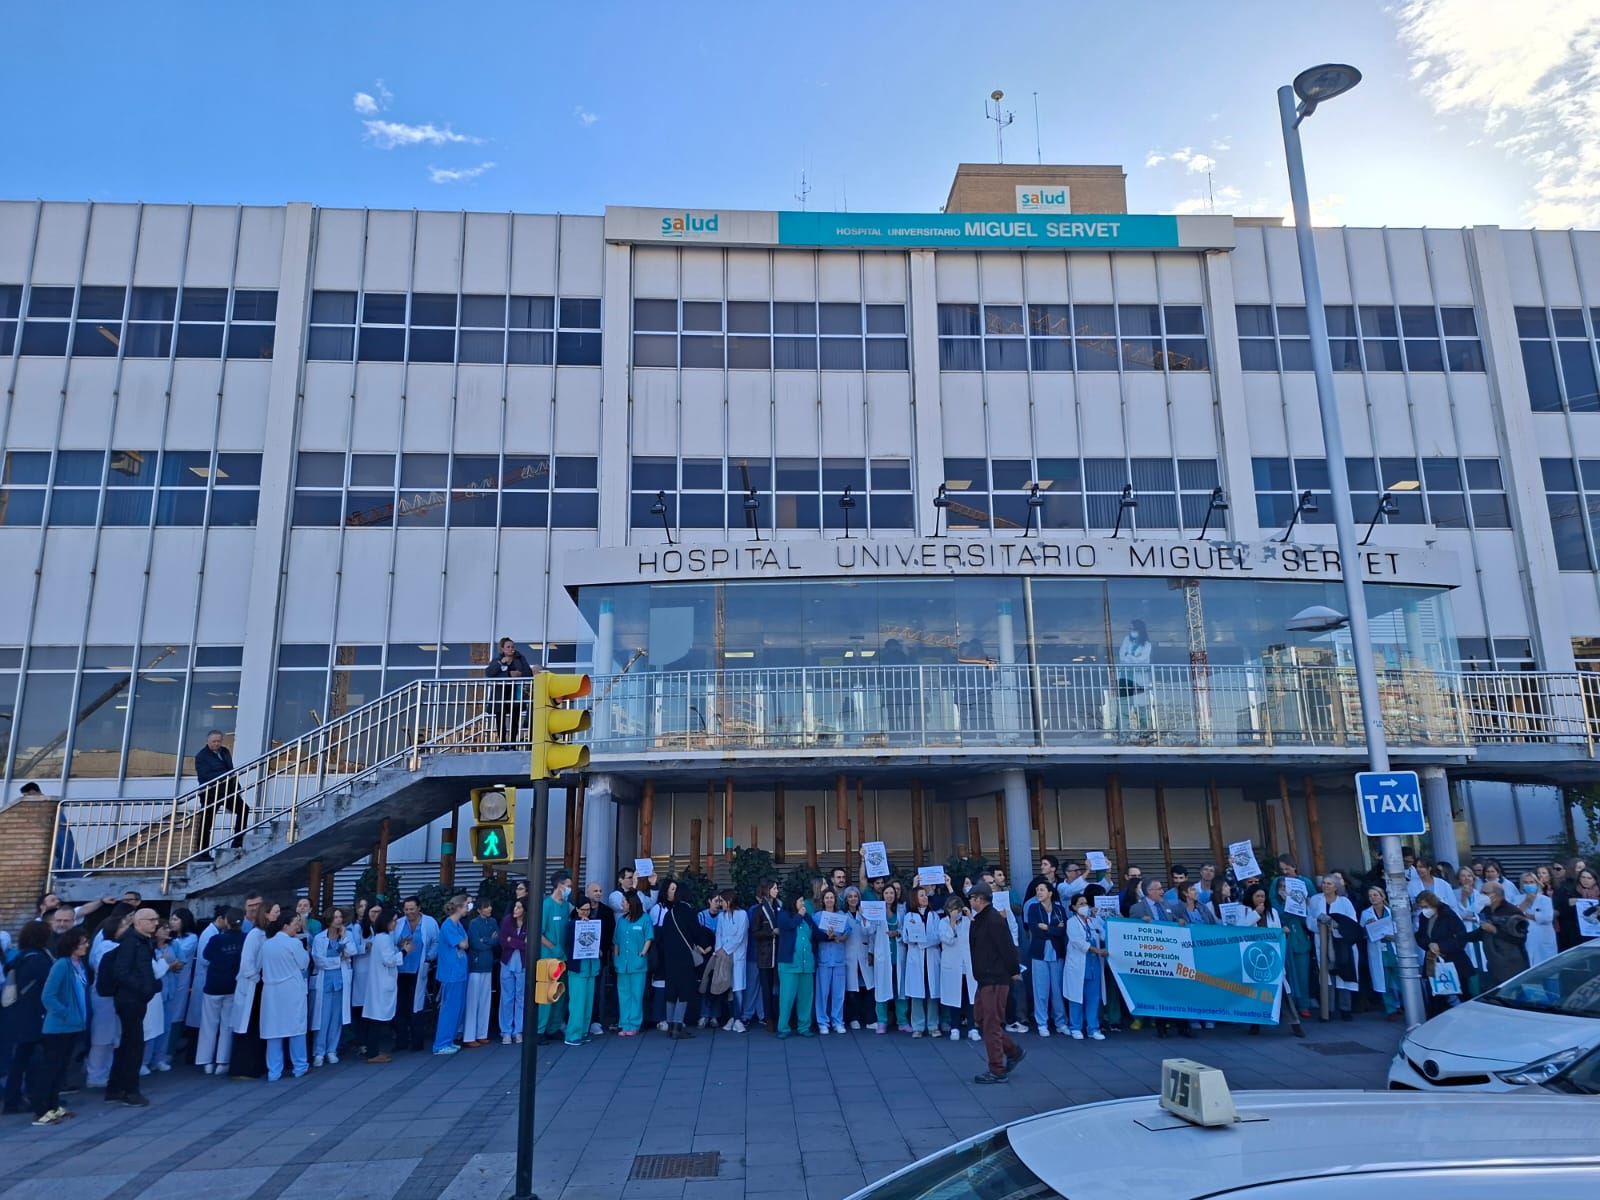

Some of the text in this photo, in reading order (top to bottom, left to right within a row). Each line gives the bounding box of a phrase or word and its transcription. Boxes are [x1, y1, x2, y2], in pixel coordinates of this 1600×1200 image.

[1022, 190, 1065, 204] salud
[661, 213, 719, 232] salud
[835, 222, 1121, 238] HOSPITAL UNIVERSITARIO MIGUEL SERVET
[639, 544, 1400, 575] HOSPITAL UNIVERSITARIO MIGUEL SERET
[1364, 794, 1419, 813] TAXI
[1123, 934, 1155, 942] ESTATUTO
[1139, 943, 1165, 951] PROPIO
[1136, 959, 1162, 967] MÉDICA
[1129, 967, 1174, 977] FACULTATIVA
[1170, 1069, 1190, 1107] 75
